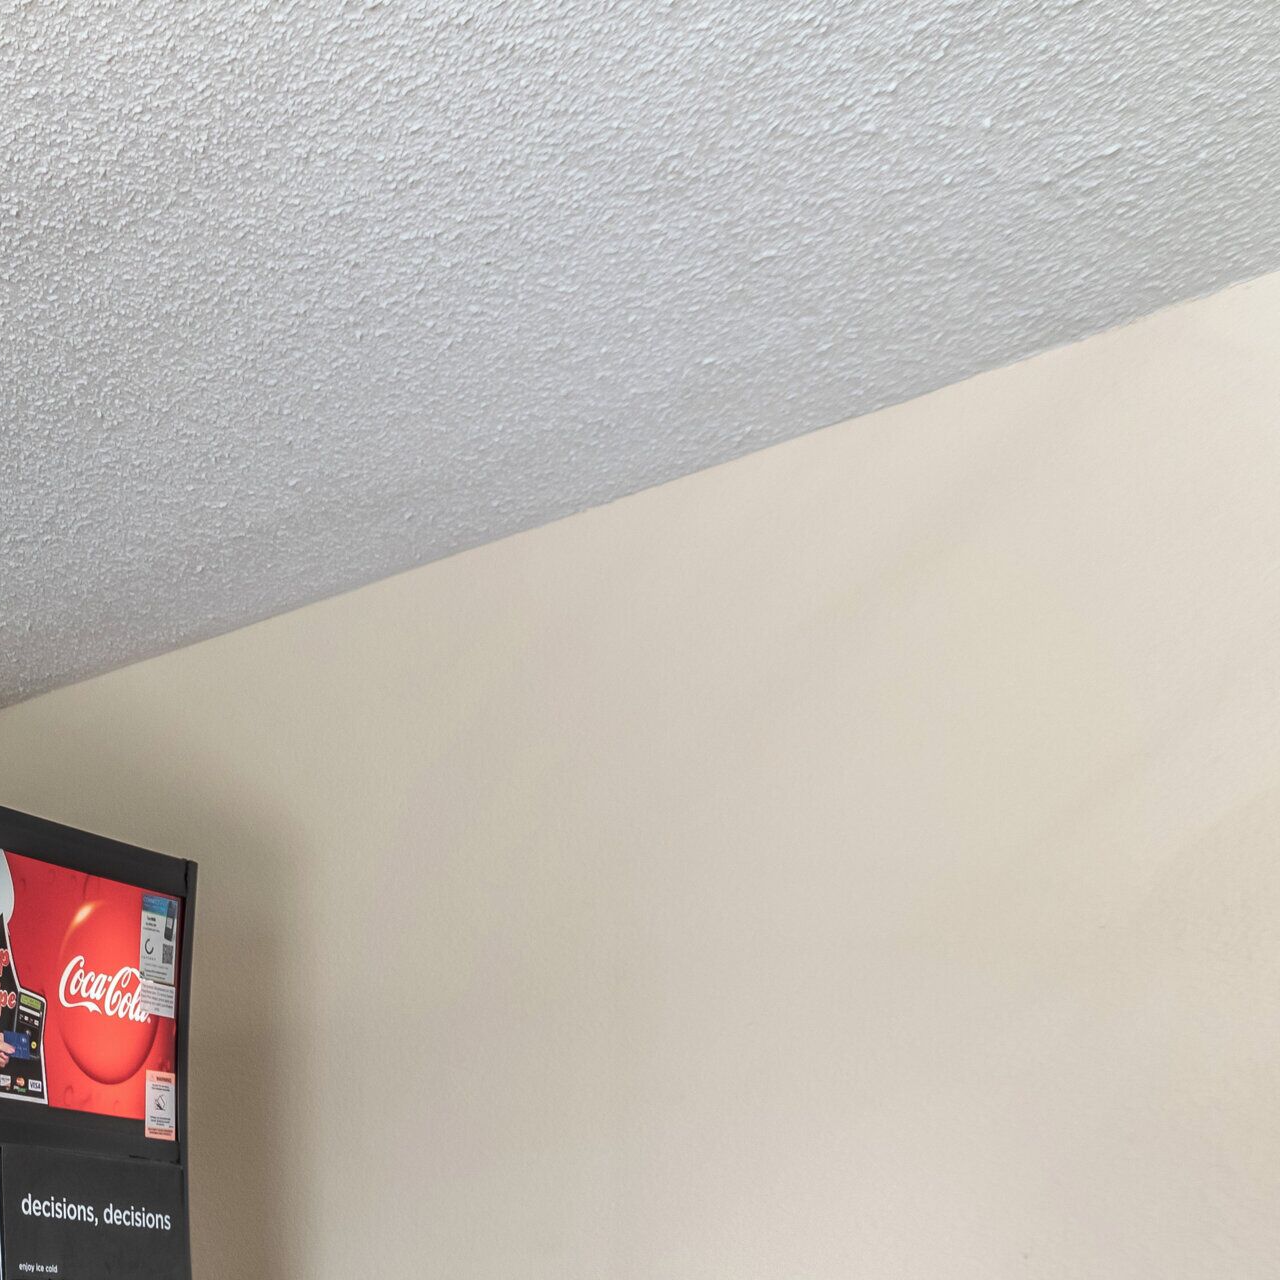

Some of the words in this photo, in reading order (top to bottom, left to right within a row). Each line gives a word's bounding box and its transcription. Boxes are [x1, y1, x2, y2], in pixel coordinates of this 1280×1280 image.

[59, 956, 149, 1023] Coca-Cola
[21, 1193, 99, 1226] decisions,
[103, 1203, 171, 1230] decisions
[19, 1263, 35, 1273] enjoy
[36, 1263, 44, 1272] ice
[45, 1265, 58, 1273] cold
